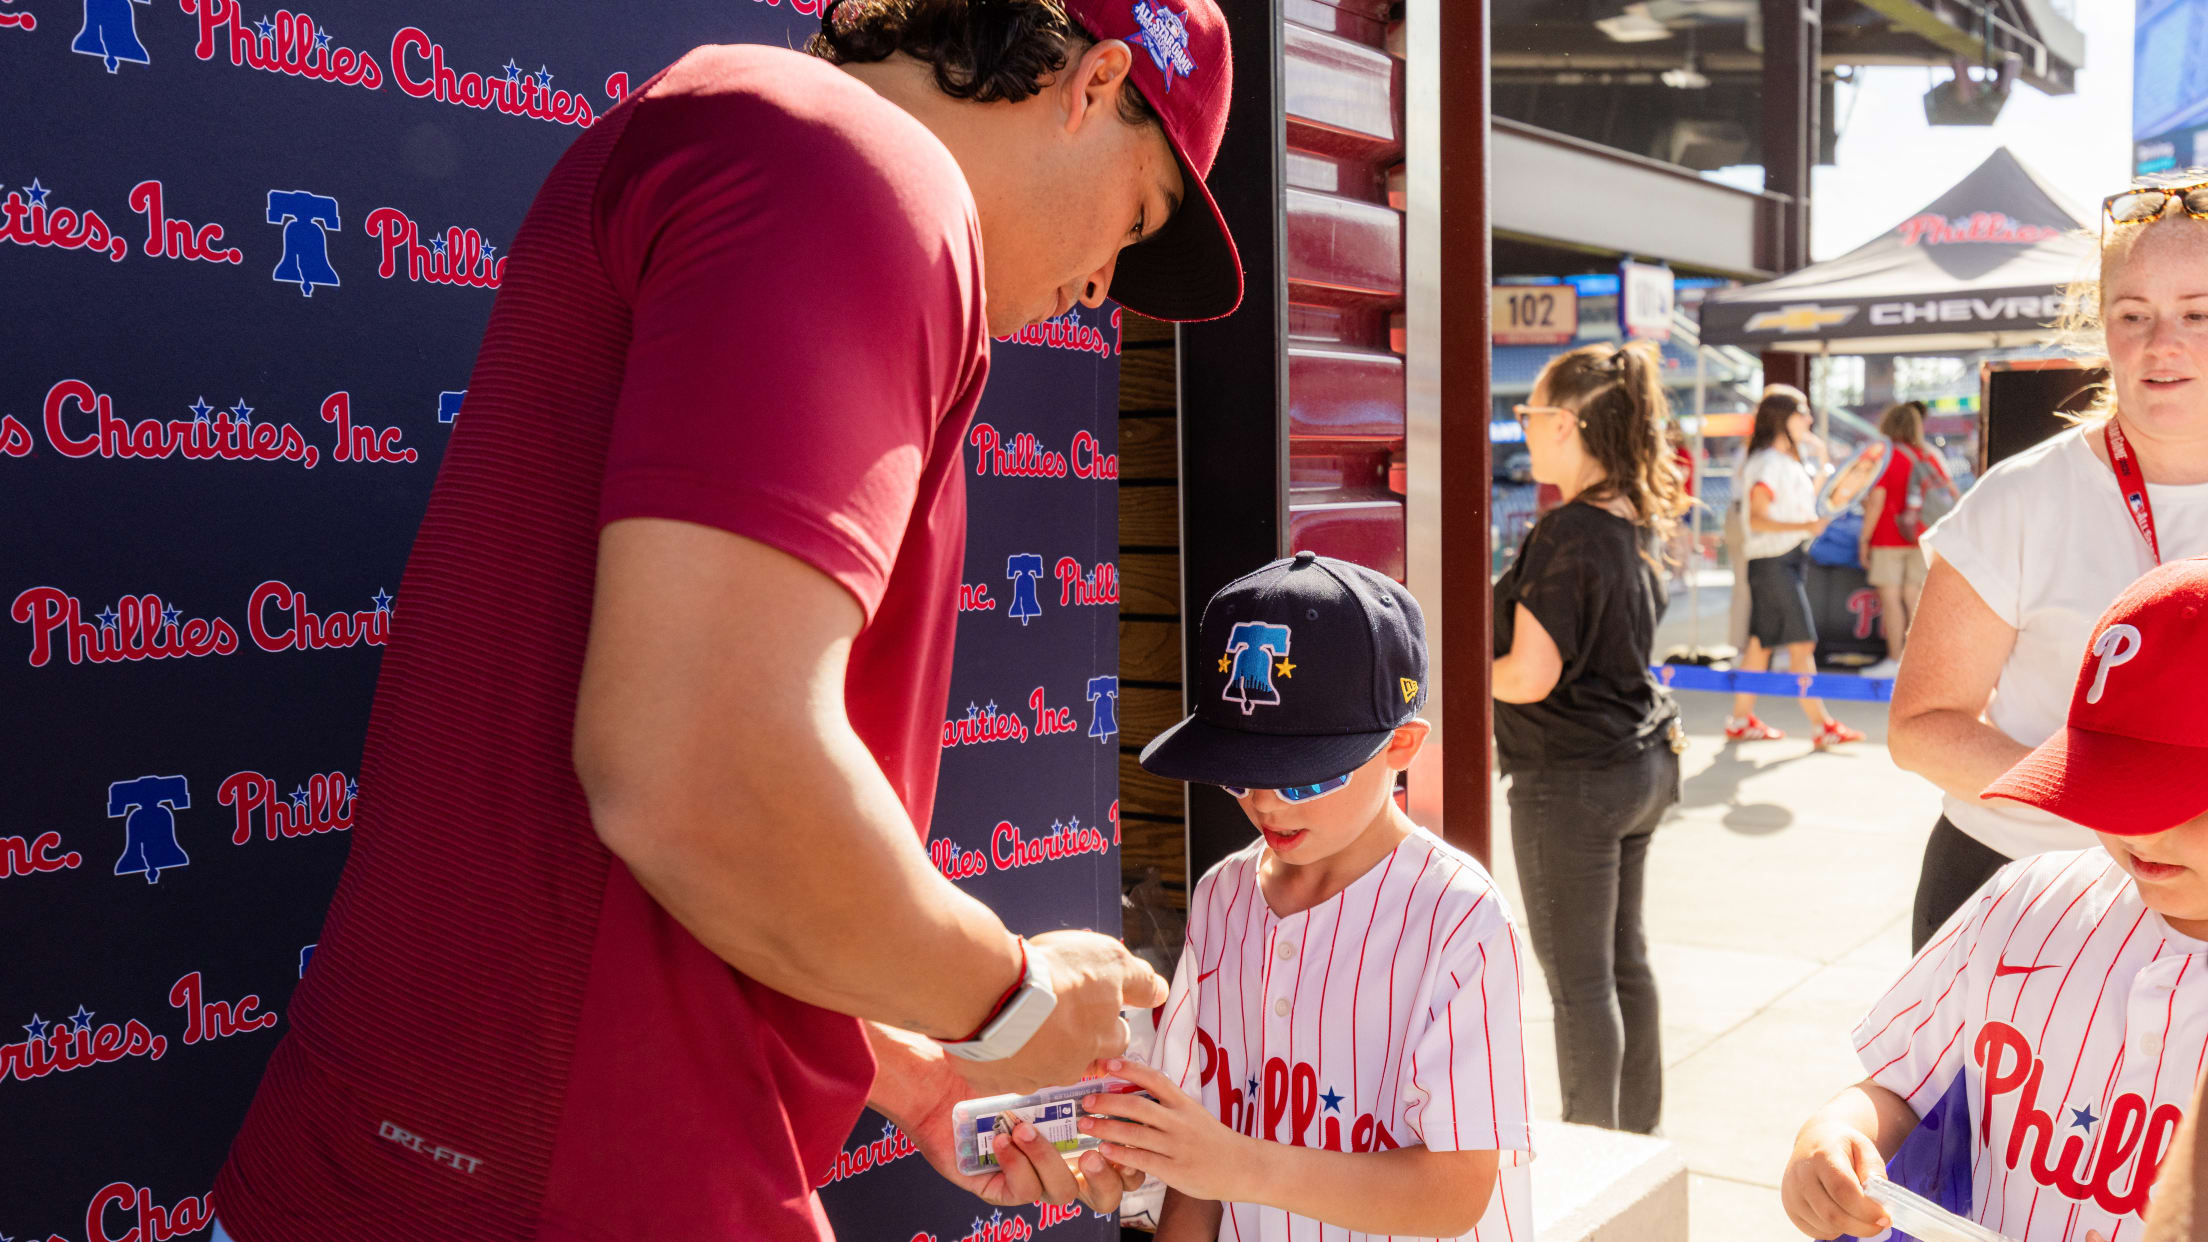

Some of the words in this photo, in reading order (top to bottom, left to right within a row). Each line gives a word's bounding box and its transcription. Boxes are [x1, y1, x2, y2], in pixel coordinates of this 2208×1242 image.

[181, 0, 383, 90] Phillies
[0, 177, 128, 262] ties,
[128, 180, 243, 265] Inc.
[364, 206, 510, 290] Philli
[1899, 210, 2061, 247] Phillies
[995, 308, 1111, 360] arities,
[1508, 293, 1556, 328] 102
[1869, 295, 2068, 326] CHEVRO
[43, 379, 320, 469] Charities,
[320, 391, 419, 463] Inc.
[970, 422, 1068, 478] Phillies
[958, 583, 996, 612] nc.
[1054, 556, 1120, 607] Philli
[11, 586, 240, 668] Phillies
[247, 580, 399, 652] Chari
[2086, 623, 2142, 704] P
[941, 699, 1028, 749] arities,
[1029, 686, 1077, 736] Inc.
[217, 770, 359, 846] Philli
[0, 831, 82, 879] nc.
[927, 837, 988, 882] llies
[991, 815, 1109, 871] Charities,
[0, 1004, 168, 1084] rities,
[169, 971, 278, 1045] Inc.
[379, 1119, 483, 1174] DRI-FIT
[1972, 1019, 2184, 1223] Phill
[816, 1120, 921, 1188] hariti
[911, 1208, 1033, 1242] ities,
